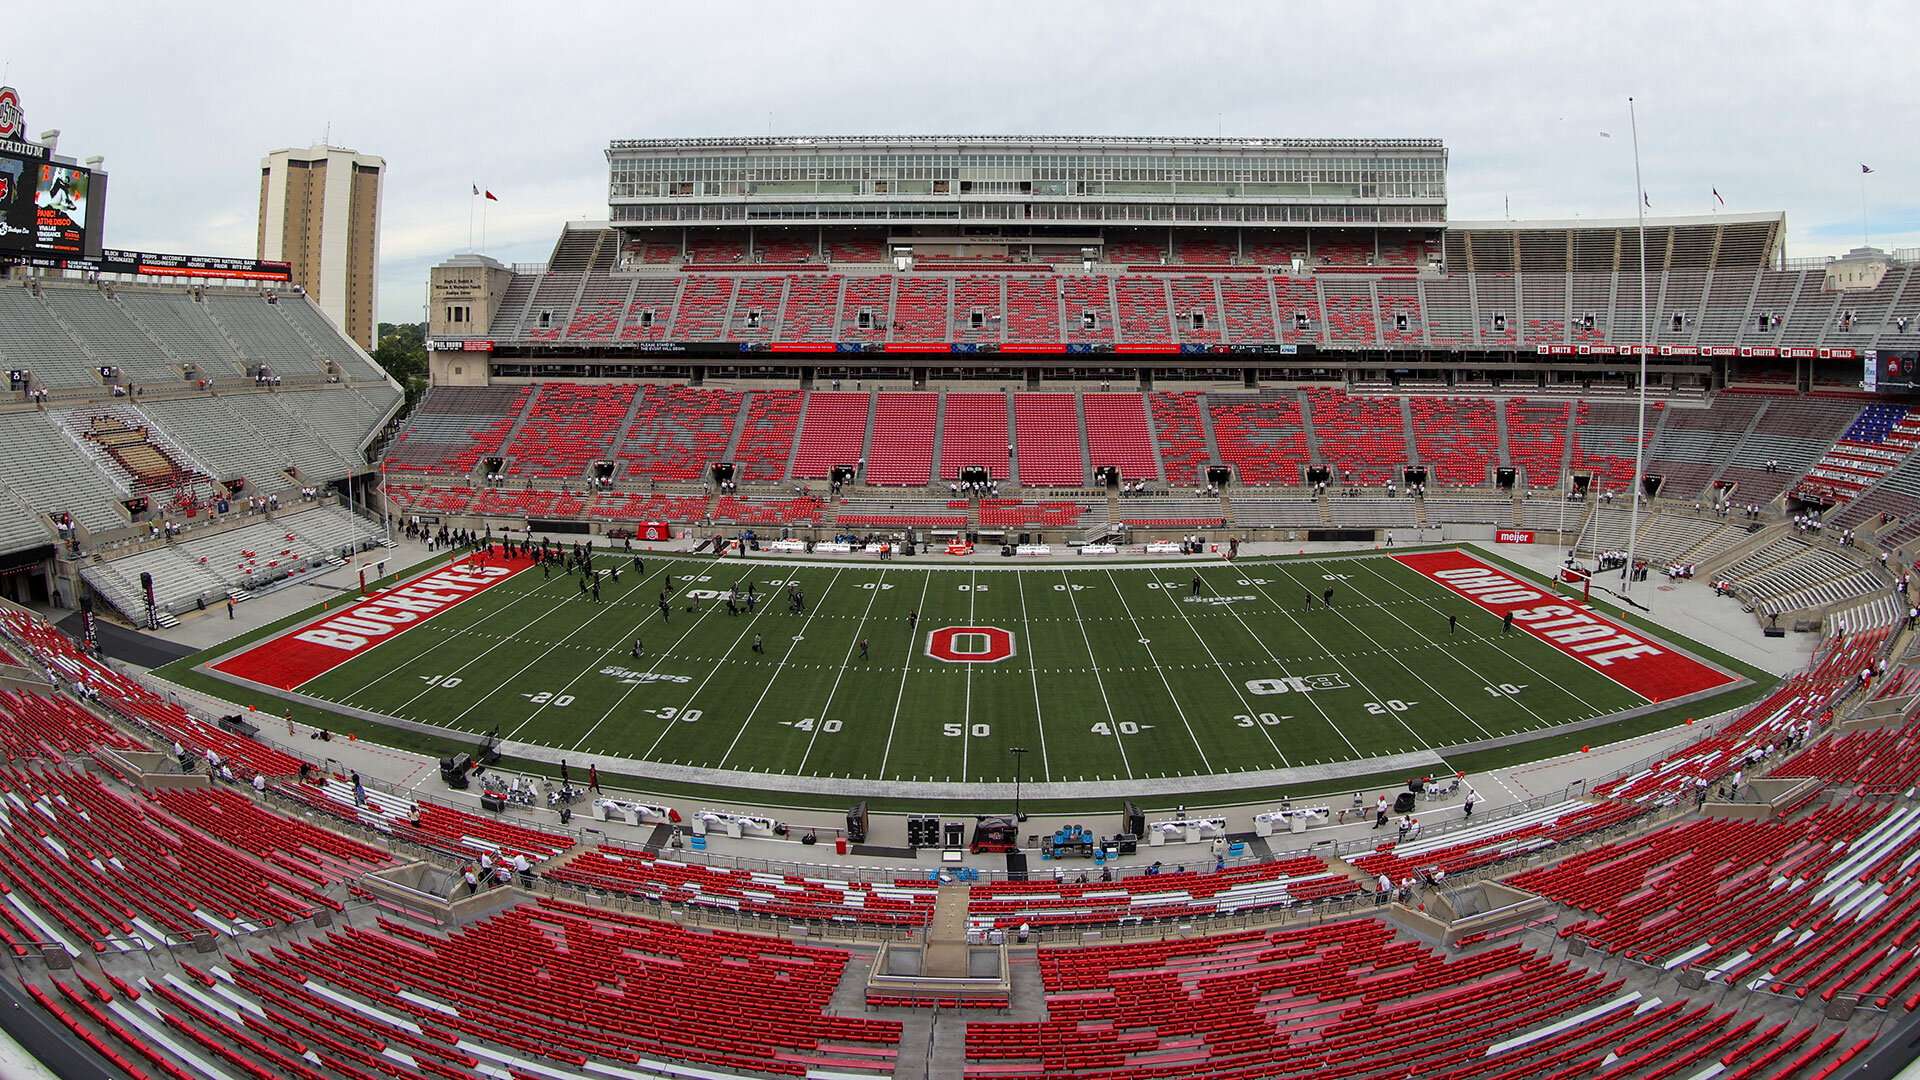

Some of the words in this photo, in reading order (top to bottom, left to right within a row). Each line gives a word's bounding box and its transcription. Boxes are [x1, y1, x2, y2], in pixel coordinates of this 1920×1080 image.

[0, 140, 44, 157] TADIUM
[1591, 346, 1615, 354] HORVATH
[1712, 347, 1736, 355] CASSADY
[1752, 348, 1775, 356] GRIFFIN
[1831, 349, 1852, 357] WILLIS
[1501, 532, 1528, 543] meijer
[1236, 578, 1267, 586] 20
[1322, 573, 1348, 581] 10
[958, 584, 989, 592] 50
[1147, 582, 1178, 590] 30
[292, 564, 511, 651] BUCKEYES
[1433, 566, 1543, 605] OHIO
[1511, 605, 1664, 666] STATE
[424, 675, 463, 688] 10
[599, 668, 693, 683] Safelite
[1484, 683, 1520, 697] 10
[530, 692, 576, 706] 20
[1363, 699, 1409, 715] 20
[656, 707, 703, 722] 30
[1233, 713, 1281, 727] 30
[793, 718, 844, 733] 40
[943, 723, 990, 737] 50
[1090, 721, 1139, 735] 40
